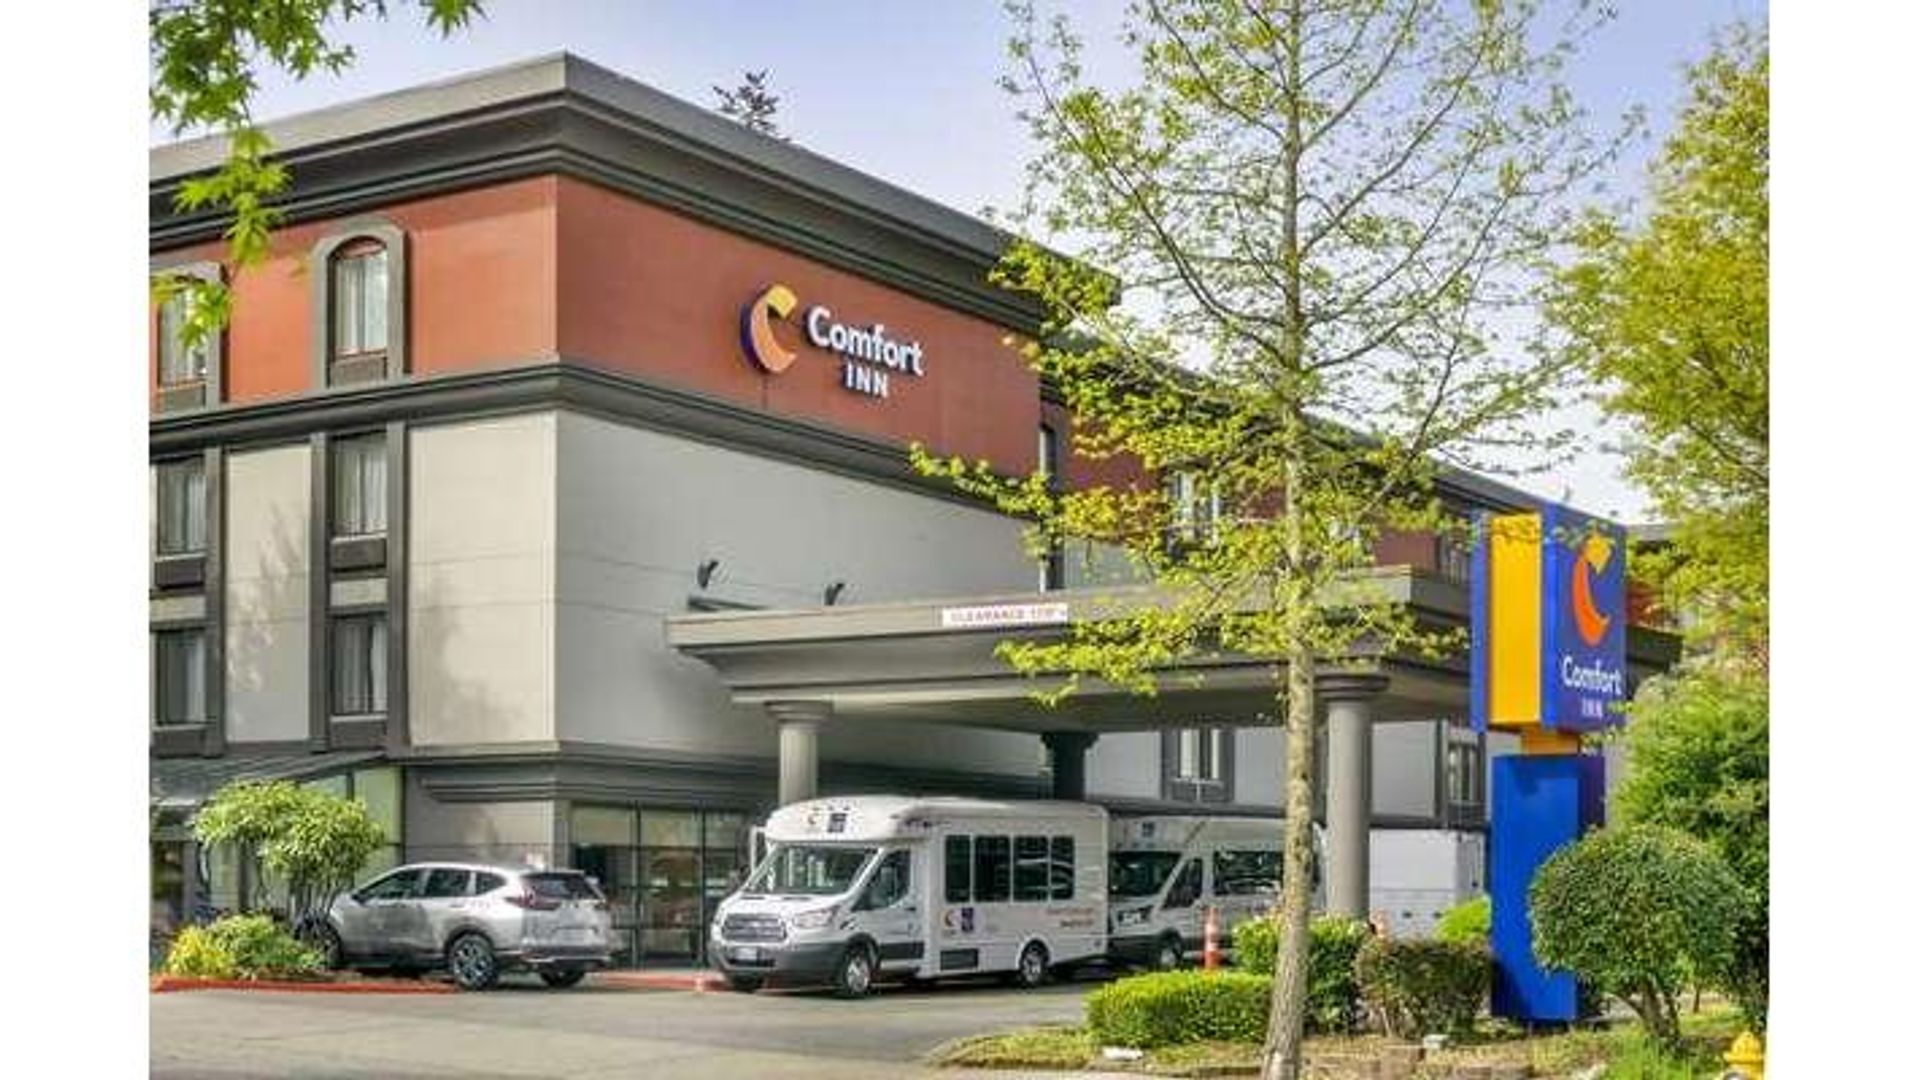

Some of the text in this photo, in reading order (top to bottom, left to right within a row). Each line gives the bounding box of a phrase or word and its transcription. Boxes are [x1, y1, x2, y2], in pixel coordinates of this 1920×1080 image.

[807, 306, 923, 376] Comfort
[845, 363, 889, 398] INN
[1562, 656, 1622, 695] Comfort
[1582, 698, 1603, 719] INN
